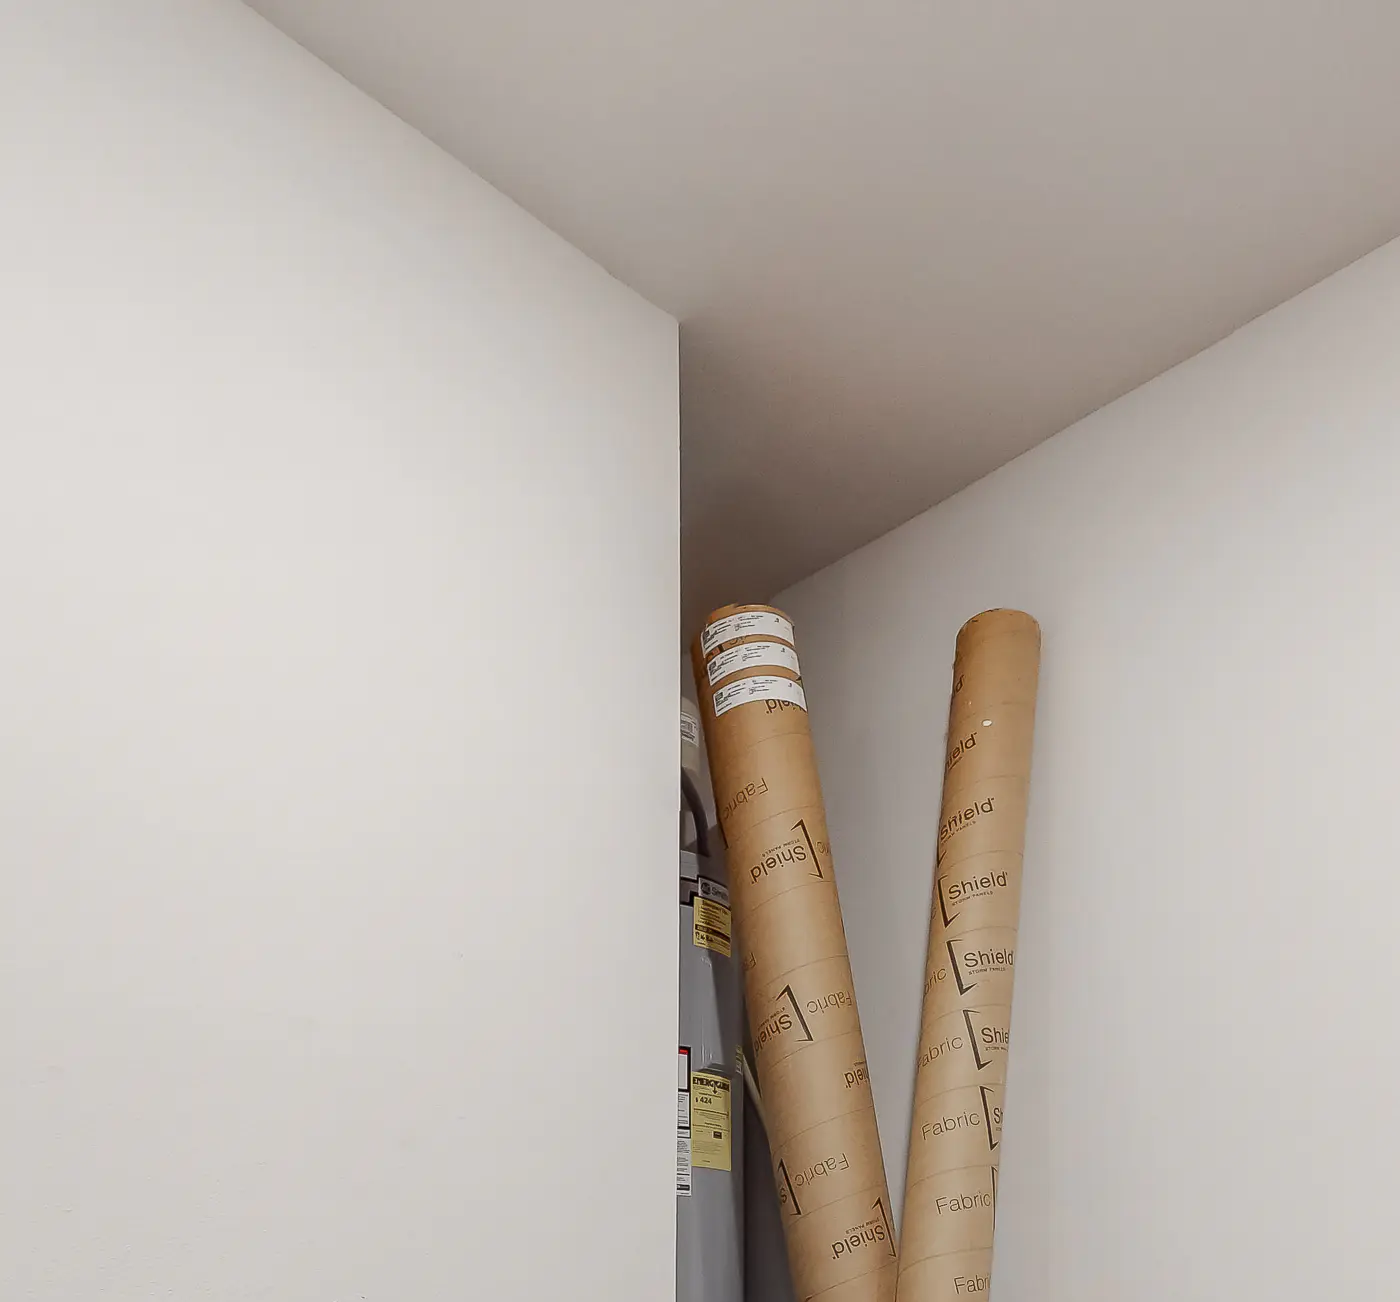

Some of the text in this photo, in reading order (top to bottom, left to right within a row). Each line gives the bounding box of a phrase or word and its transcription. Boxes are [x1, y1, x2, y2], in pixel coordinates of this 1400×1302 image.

[722, 778, 768, 820] Fabric
[750, 845, 807, 884] Shield
[948, 871, 1008, 901] Shield
[921, 1111, 981, 1141] Fabric
[794, 1153, 850, 1187] Fabric
[935, 1191, 992, 1215] Fabric
[832, 1224, 885, 1260] Shield
